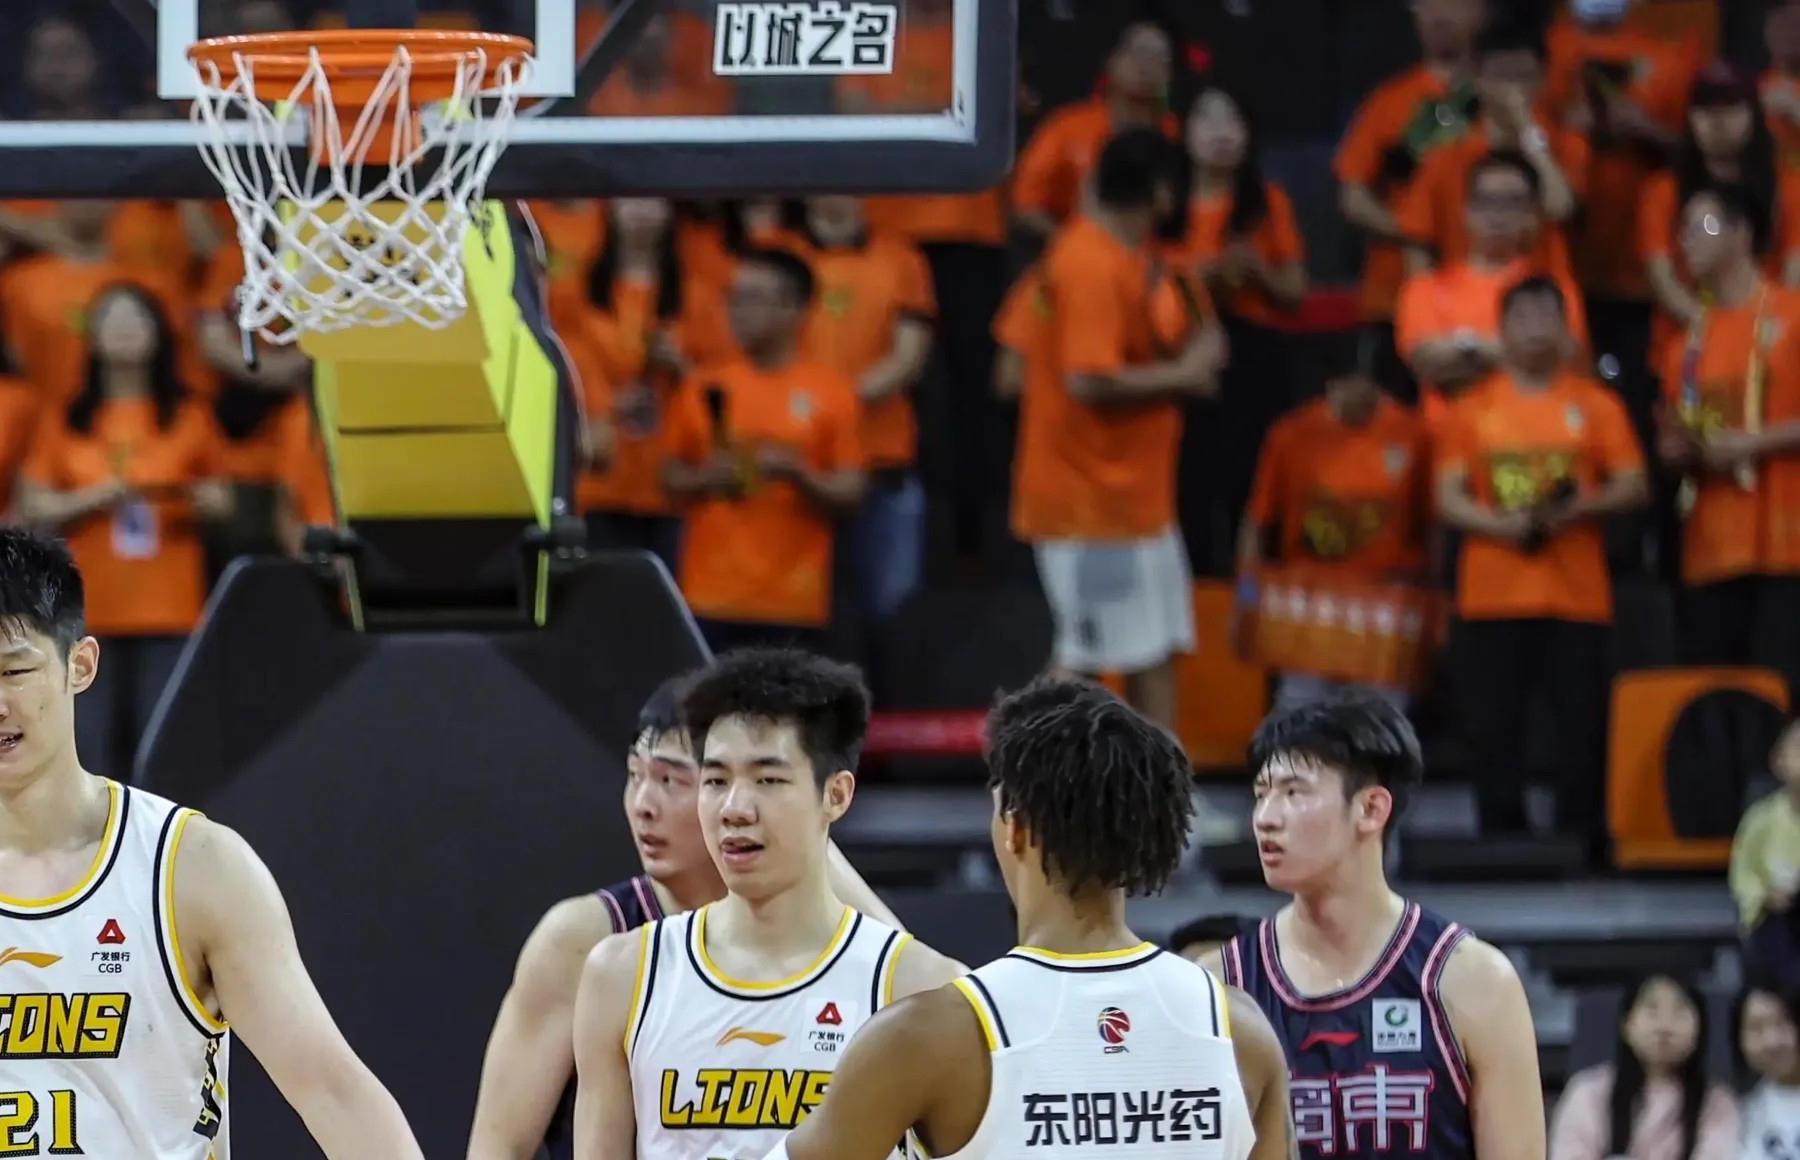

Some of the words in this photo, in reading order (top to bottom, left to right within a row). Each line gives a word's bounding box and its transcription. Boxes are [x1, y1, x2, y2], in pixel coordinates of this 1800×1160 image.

[720, 8, 890, 67] 以城之名
[90, 951, 131, 962] 广发银行
[98, 963, 123, 974] CGB
[808, 1030, 845, 1042] 广发银行
[813, 1042, 837, 1053] CGB
[1023, 1087, 1223, 1147] 东阳光药
